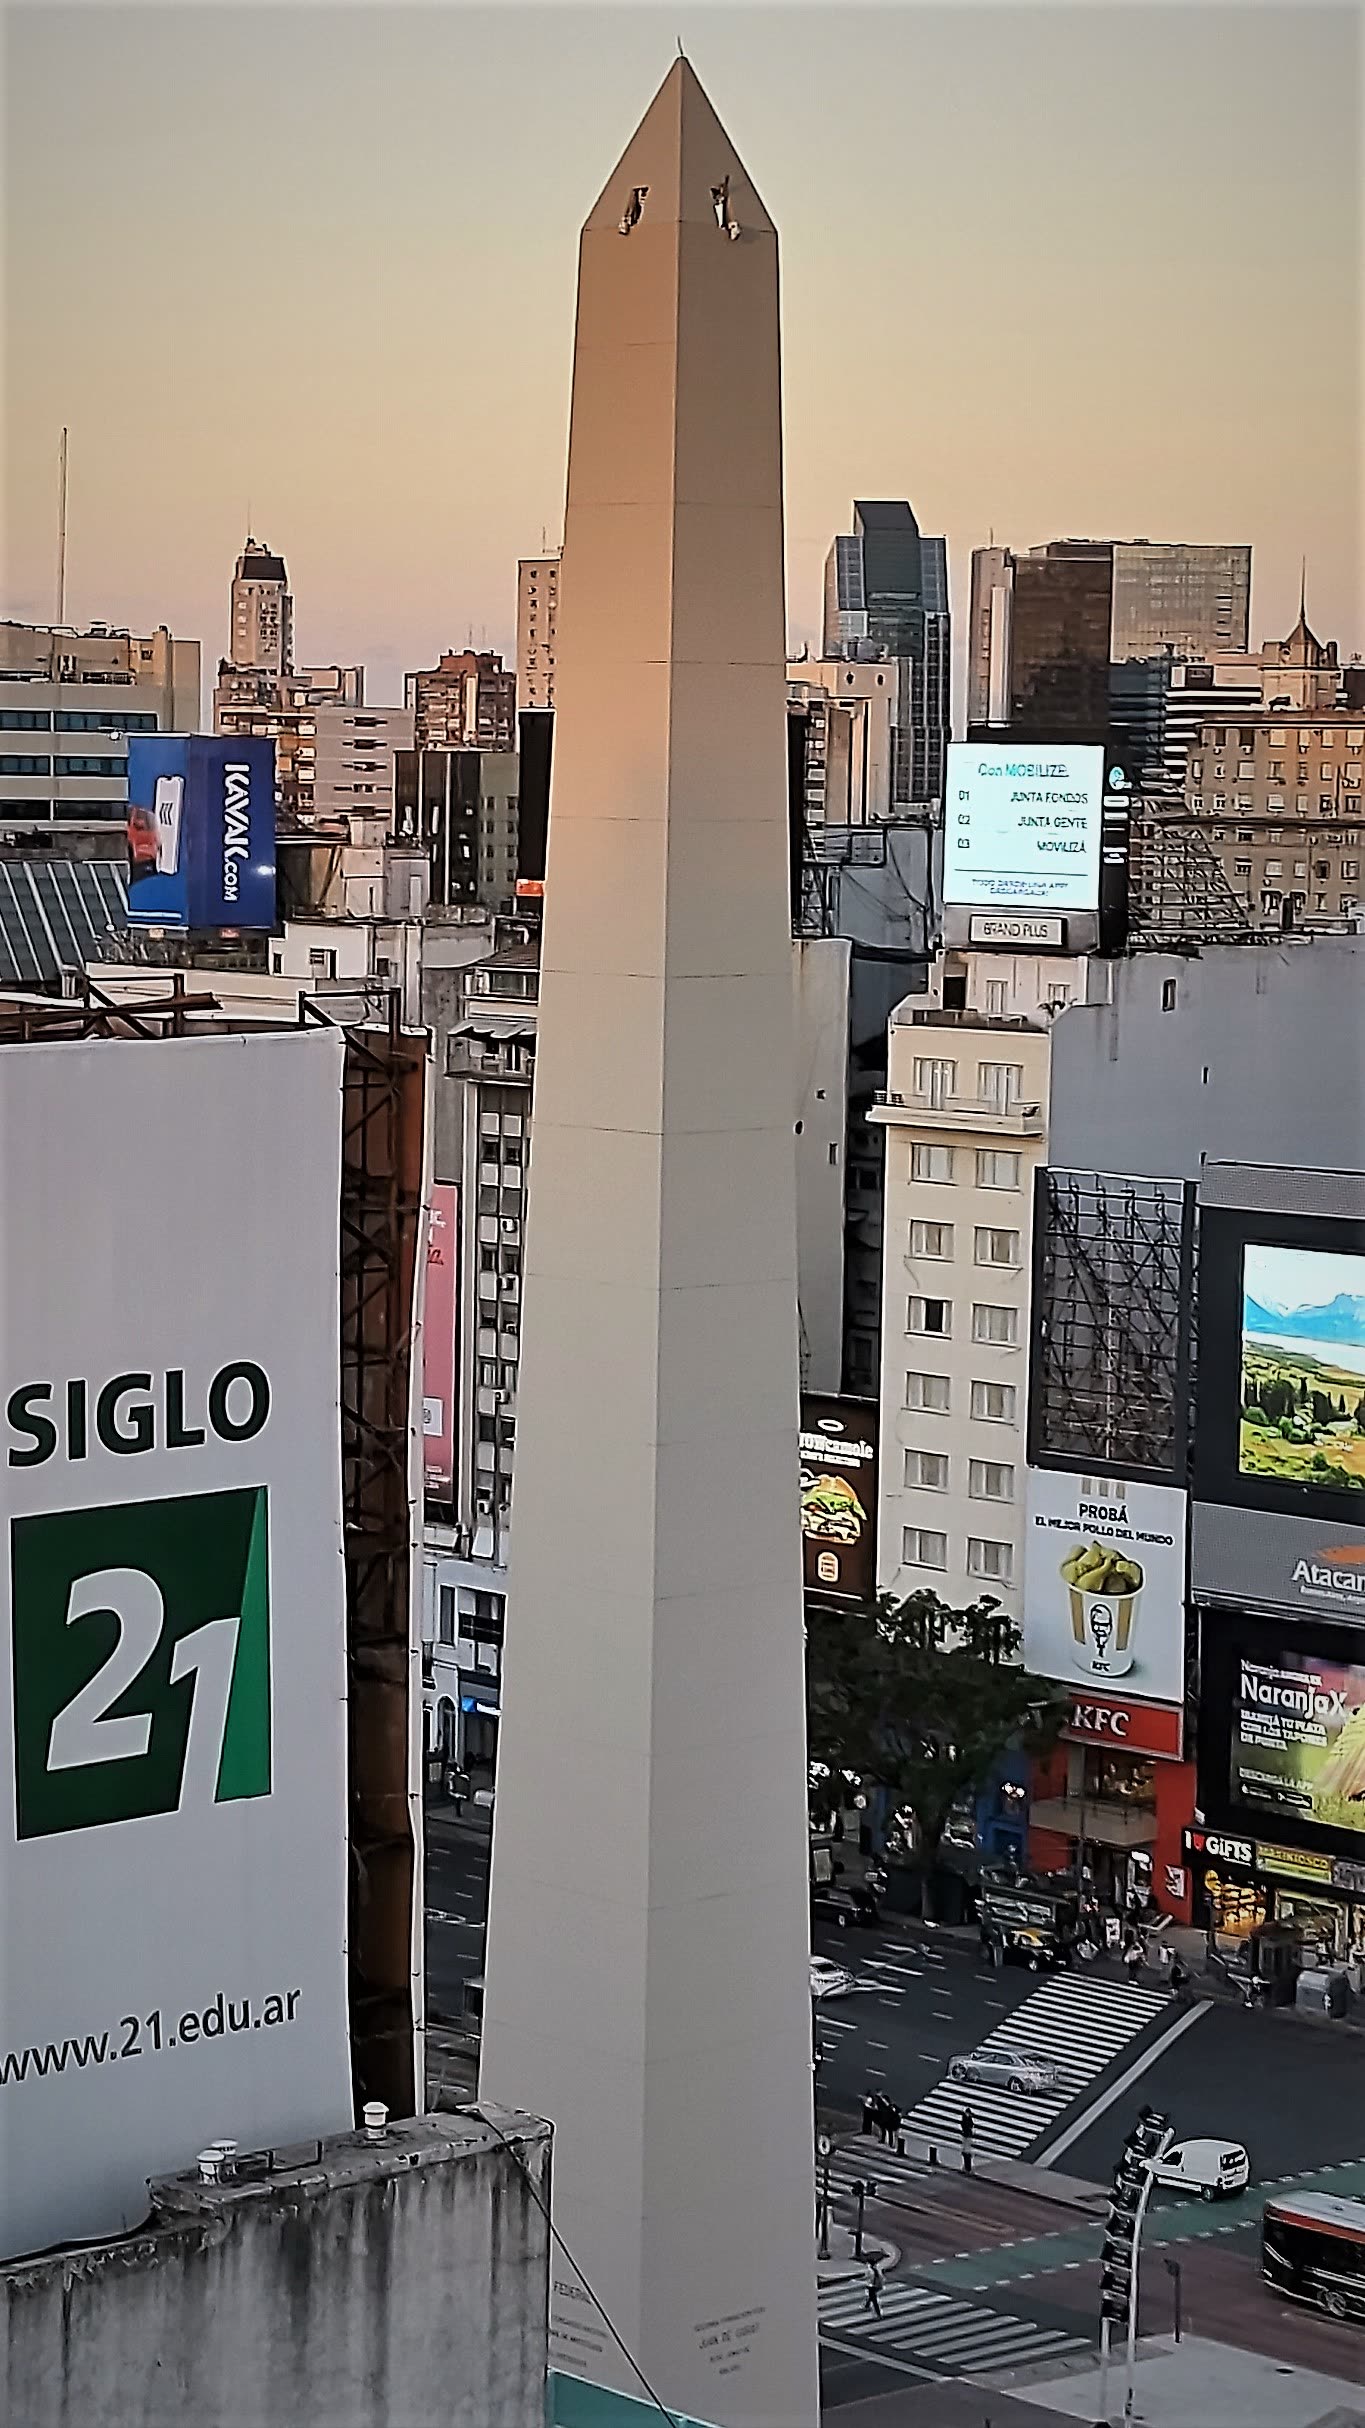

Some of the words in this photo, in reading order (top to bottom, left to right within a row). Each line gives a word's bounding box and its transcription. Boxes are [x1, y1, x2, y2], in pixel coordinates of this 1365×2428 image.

[7, 1361, 271, 1467] SIGLO
[1079, 1503, 1128, 1524] PROBÁ
[1035, 1516, 1047, 1526] EL
[1083, 1523, 1114, 1536] POLLO
[1116, 1528, 1134, 1540] DEL
[1092, 1660, 1111, 1671] KFC
[46, 1568, 241, 1812] 21
[1072, 1704, 1130, 1736] KFC
[1185, 1830, 1192, 1849] I
